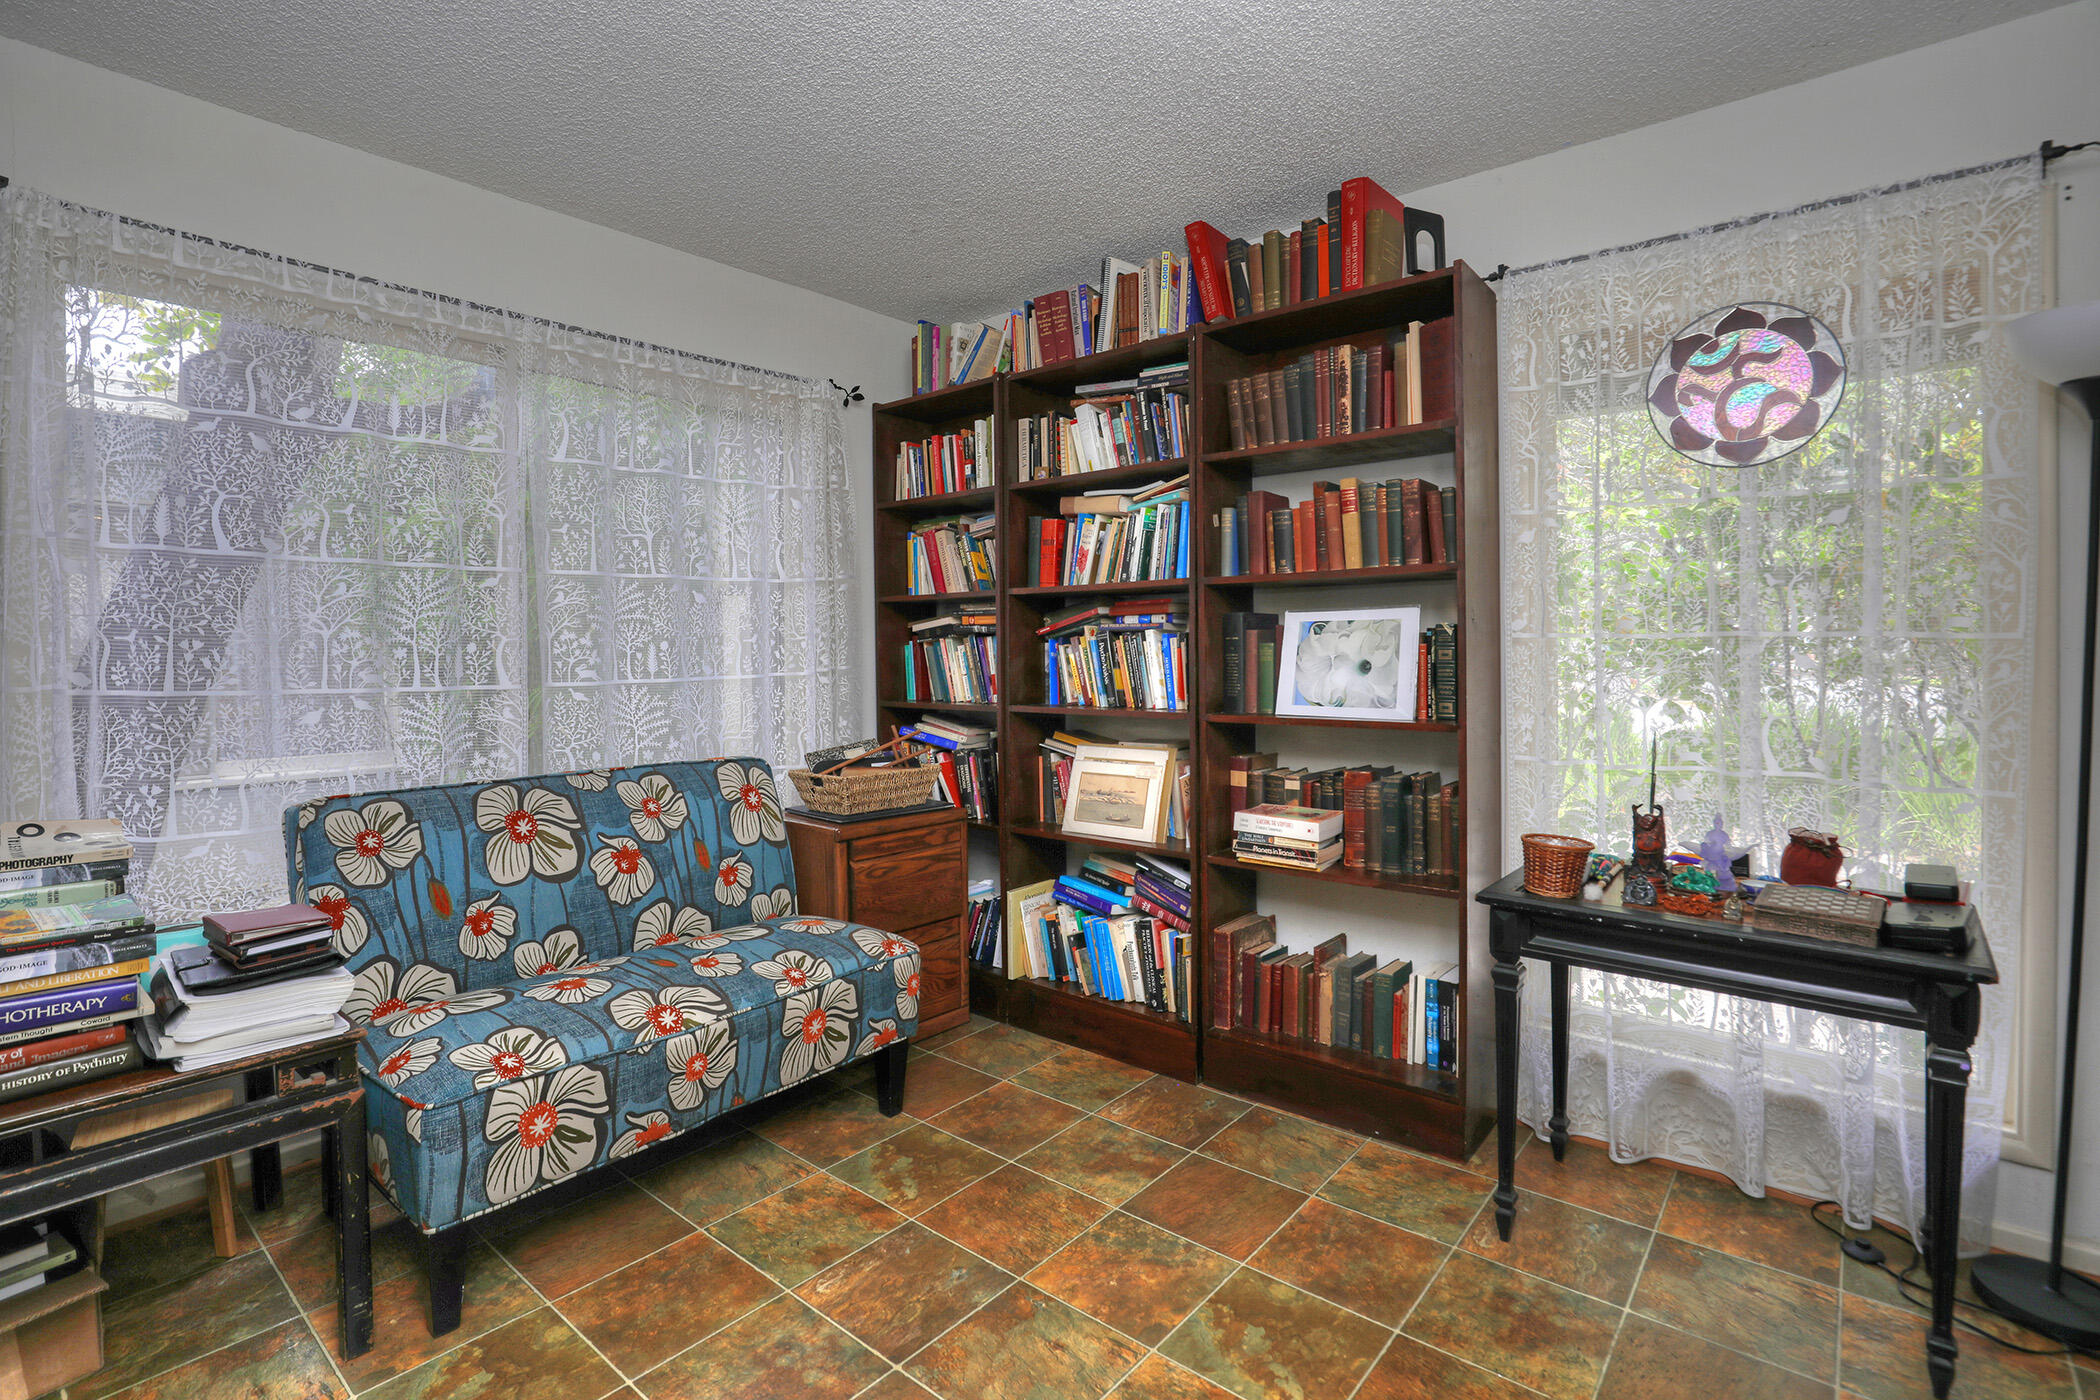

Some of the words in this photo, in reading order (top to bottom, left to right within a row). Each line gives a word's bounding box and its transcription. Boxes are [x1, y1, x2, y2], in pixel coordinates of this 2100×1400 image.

[1162, 264, 1170, 290] IDIOT'S
[1253, 845, 1272, 854] Planets
[1279, 849, 1298, 857] Transit
[0, 855, 74, 871] PHOTOGRAPHY
[16, 979, 45, 992] AND
[48, 965, 120, 986] LIBERATION
[80, 1016, 111, 1026] Coward
[21, 1026, 54, 1039] Thought
[1, 1071, 54, 1092] HISTORY
[55, 1066, 71, 1078] OF
[72, 1052, 128, 1075] Psychiatry
